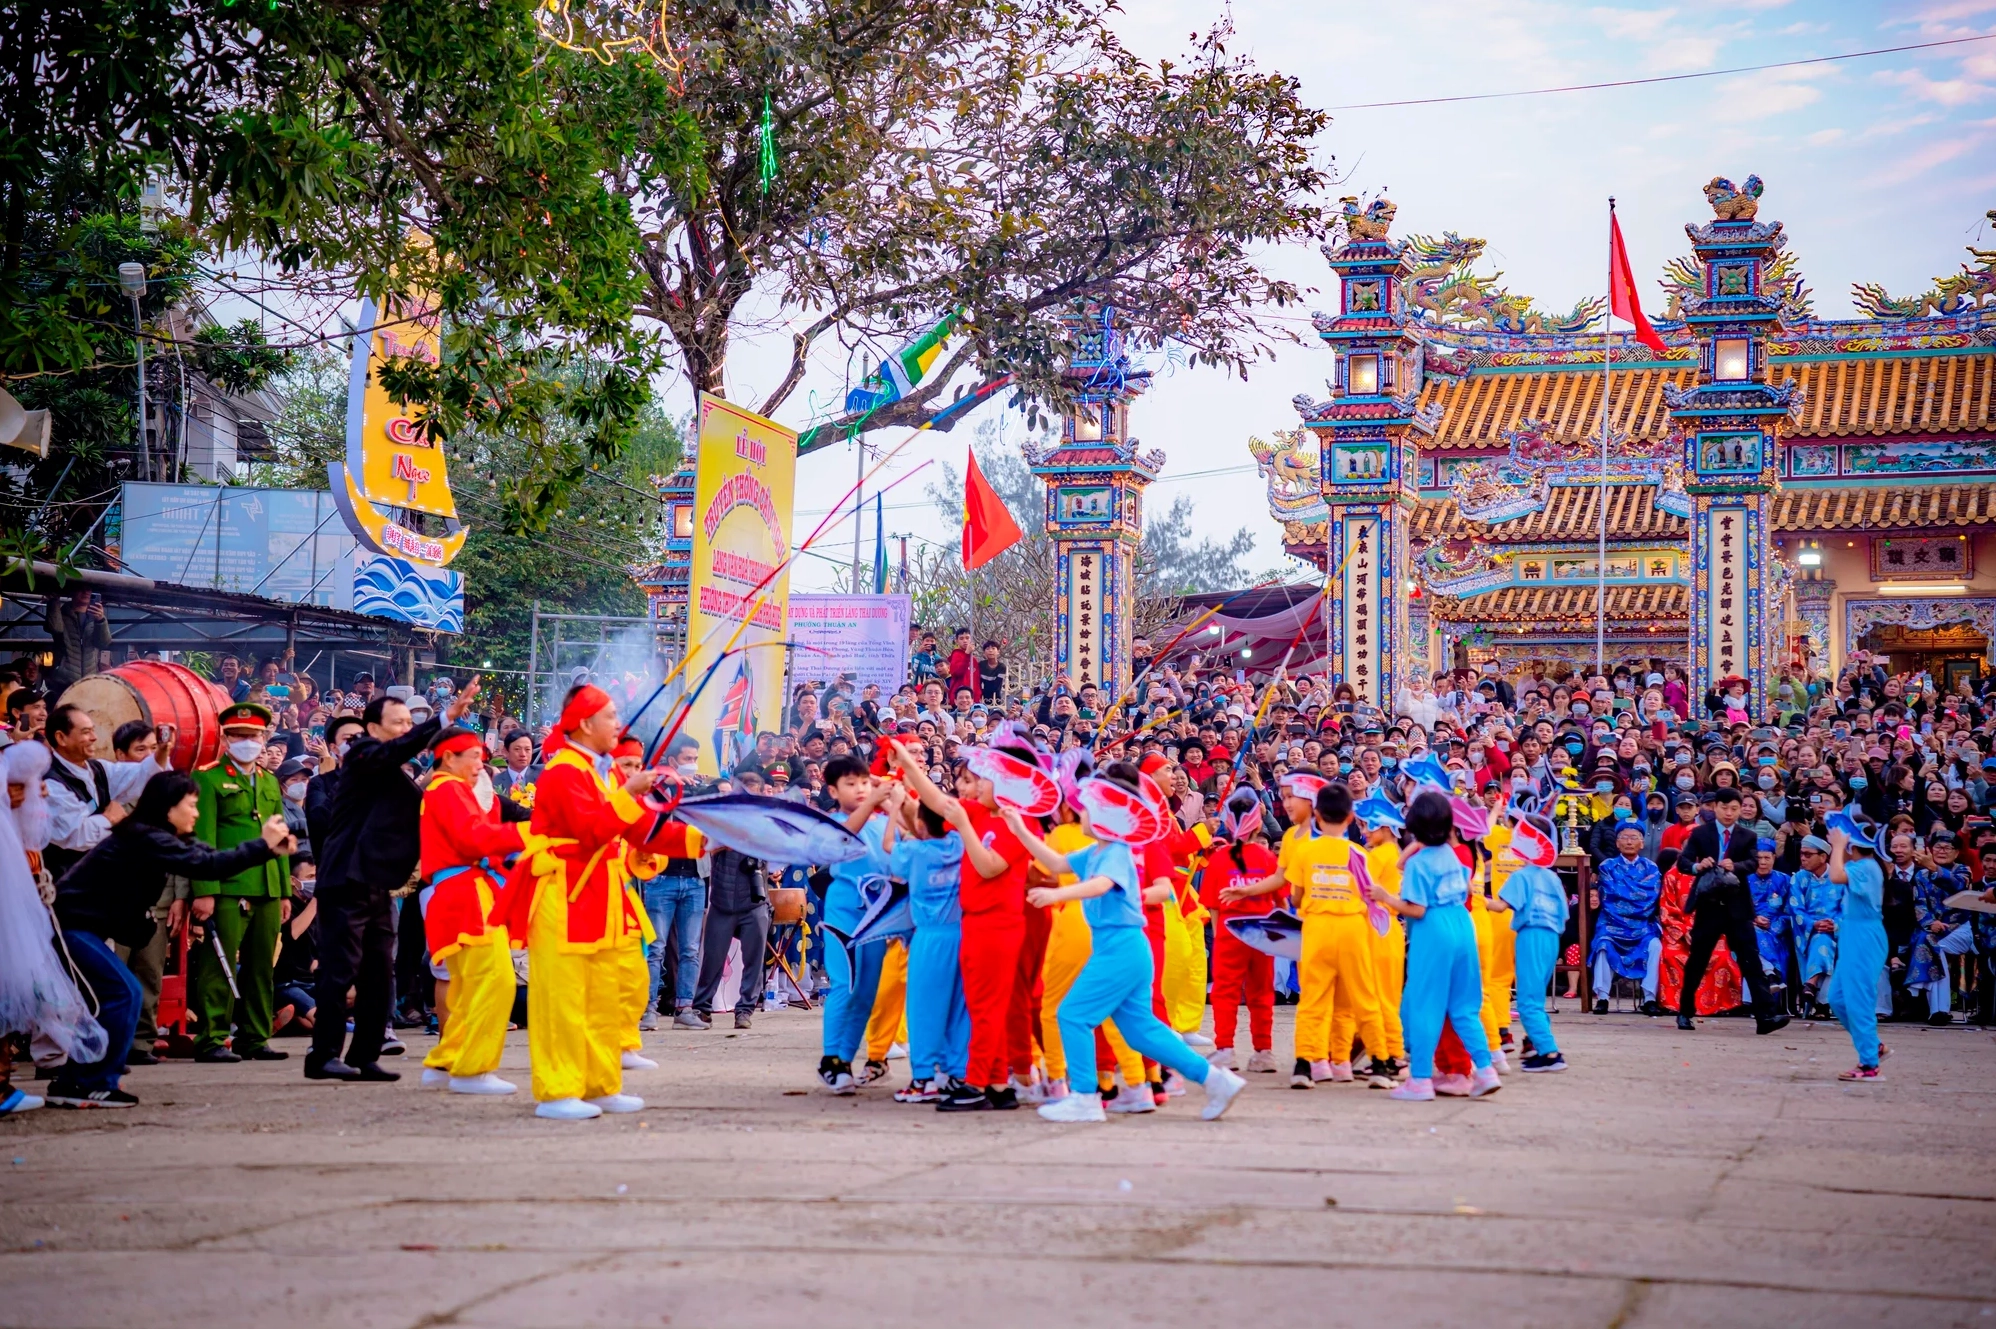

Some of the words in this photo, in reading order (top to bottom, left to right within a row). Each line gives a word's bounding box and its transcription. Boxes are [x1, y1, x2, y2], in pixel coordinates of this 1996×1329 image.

[749, 438, 766, 467] HỘI
[795, 606, 808, 620] DỰNG
[809, 605, 816, 617] VÀ
[816, 605, 829, 618] PHÁT
[845, 605, 858, 618] LÀNG
